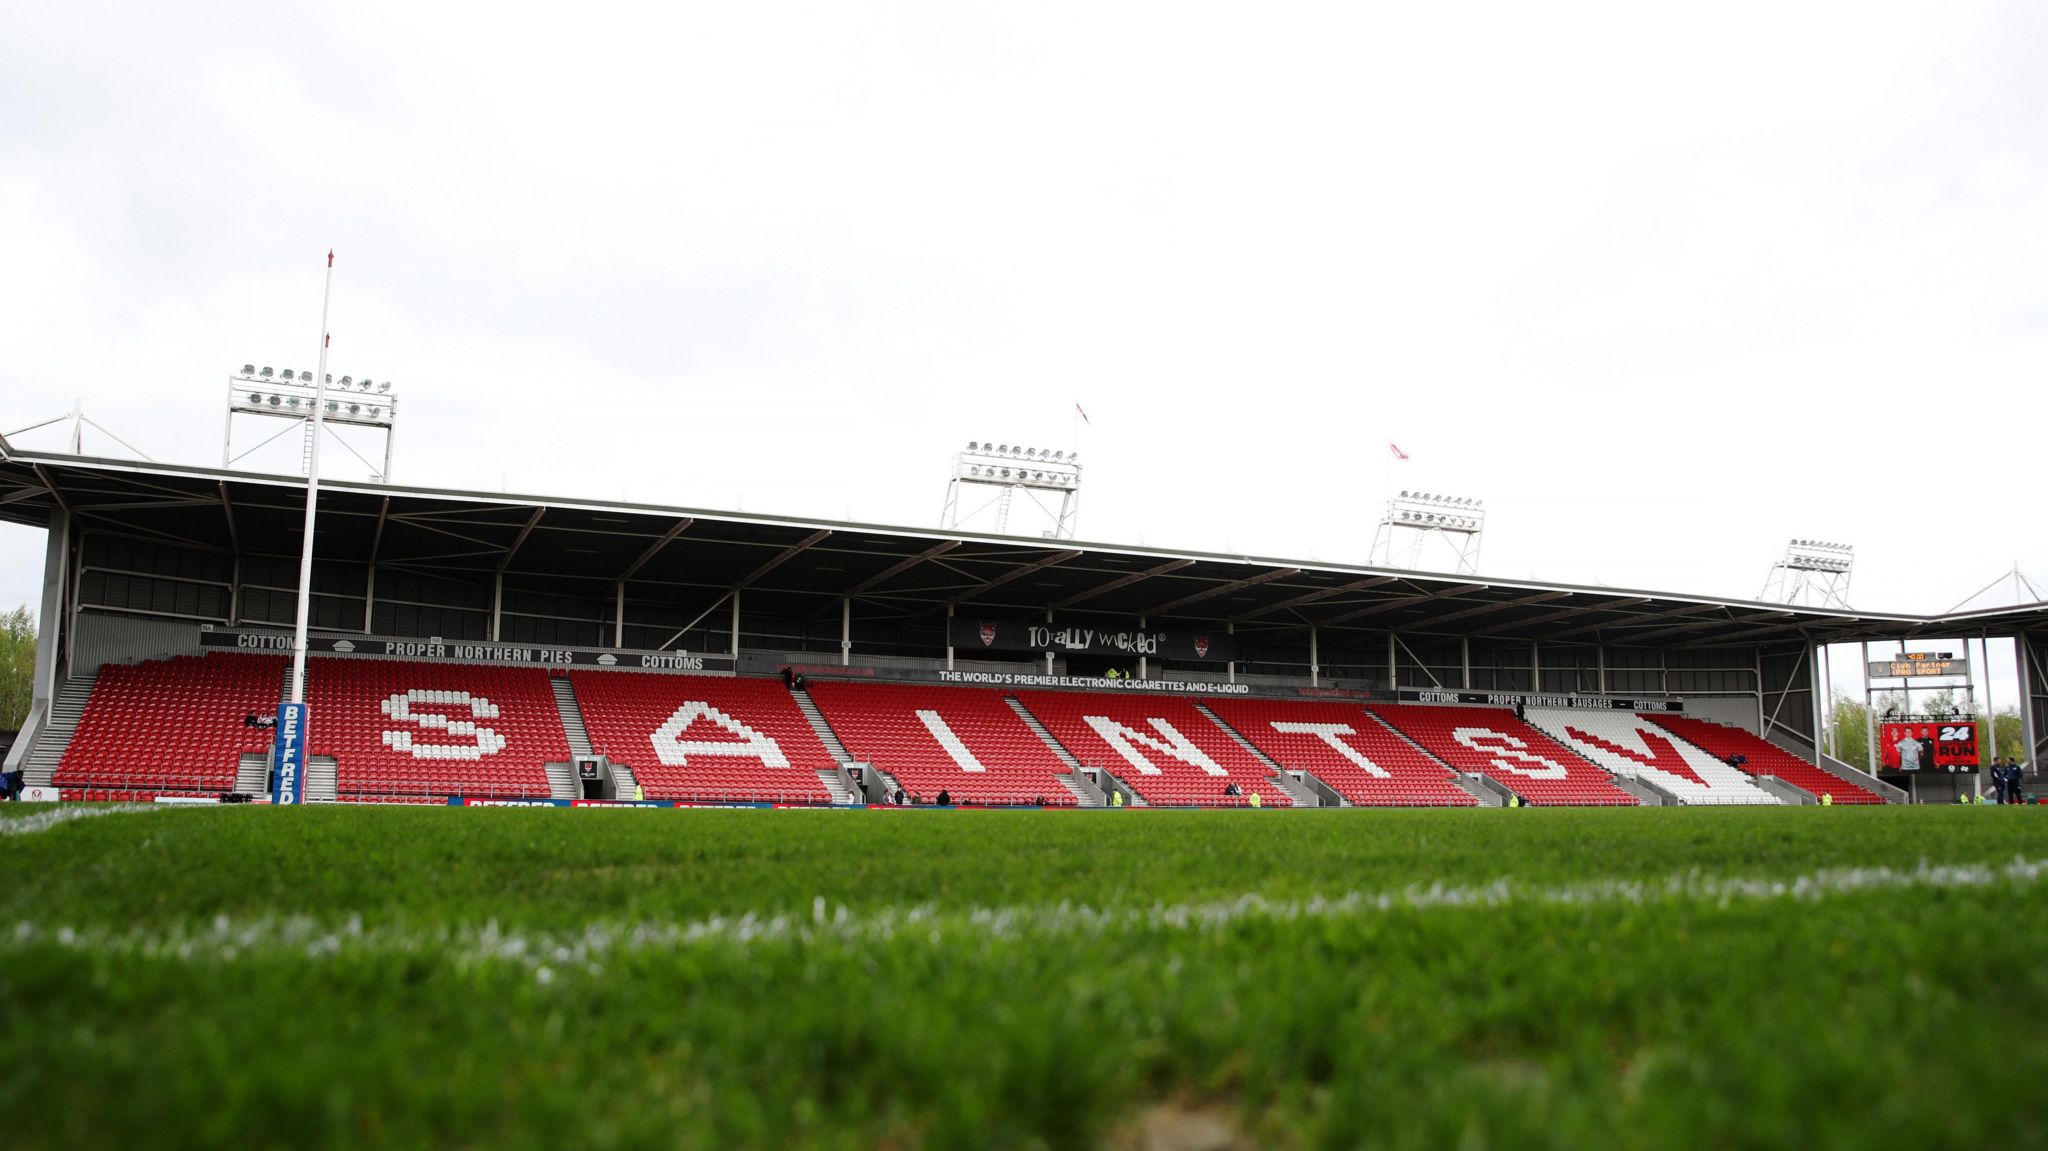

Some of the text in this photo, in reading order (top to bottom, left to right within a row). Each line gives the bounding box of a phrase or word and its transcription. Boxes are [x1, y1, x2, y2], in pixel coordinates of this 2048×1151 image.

[385, 642, 573, 664] PROPER NORTHERN PIES
[641, 655, 703, 670] COTTOMS
[1915, 661, 1951, 669] Partner
[939, 671, 1249, 694] THE WORLD'S PREMIER ELECTRONIC CIGARETTES AND E-LIQUID
[1419, 691, 1667, 711] COTTOMS PROPER NORTHERN SAUSAGES COTTOMS
[1939, 726, 1970, 741] 24
[279, 706, 299, 805] BETFRED
[1939, 745, 1975, 756] RUN
